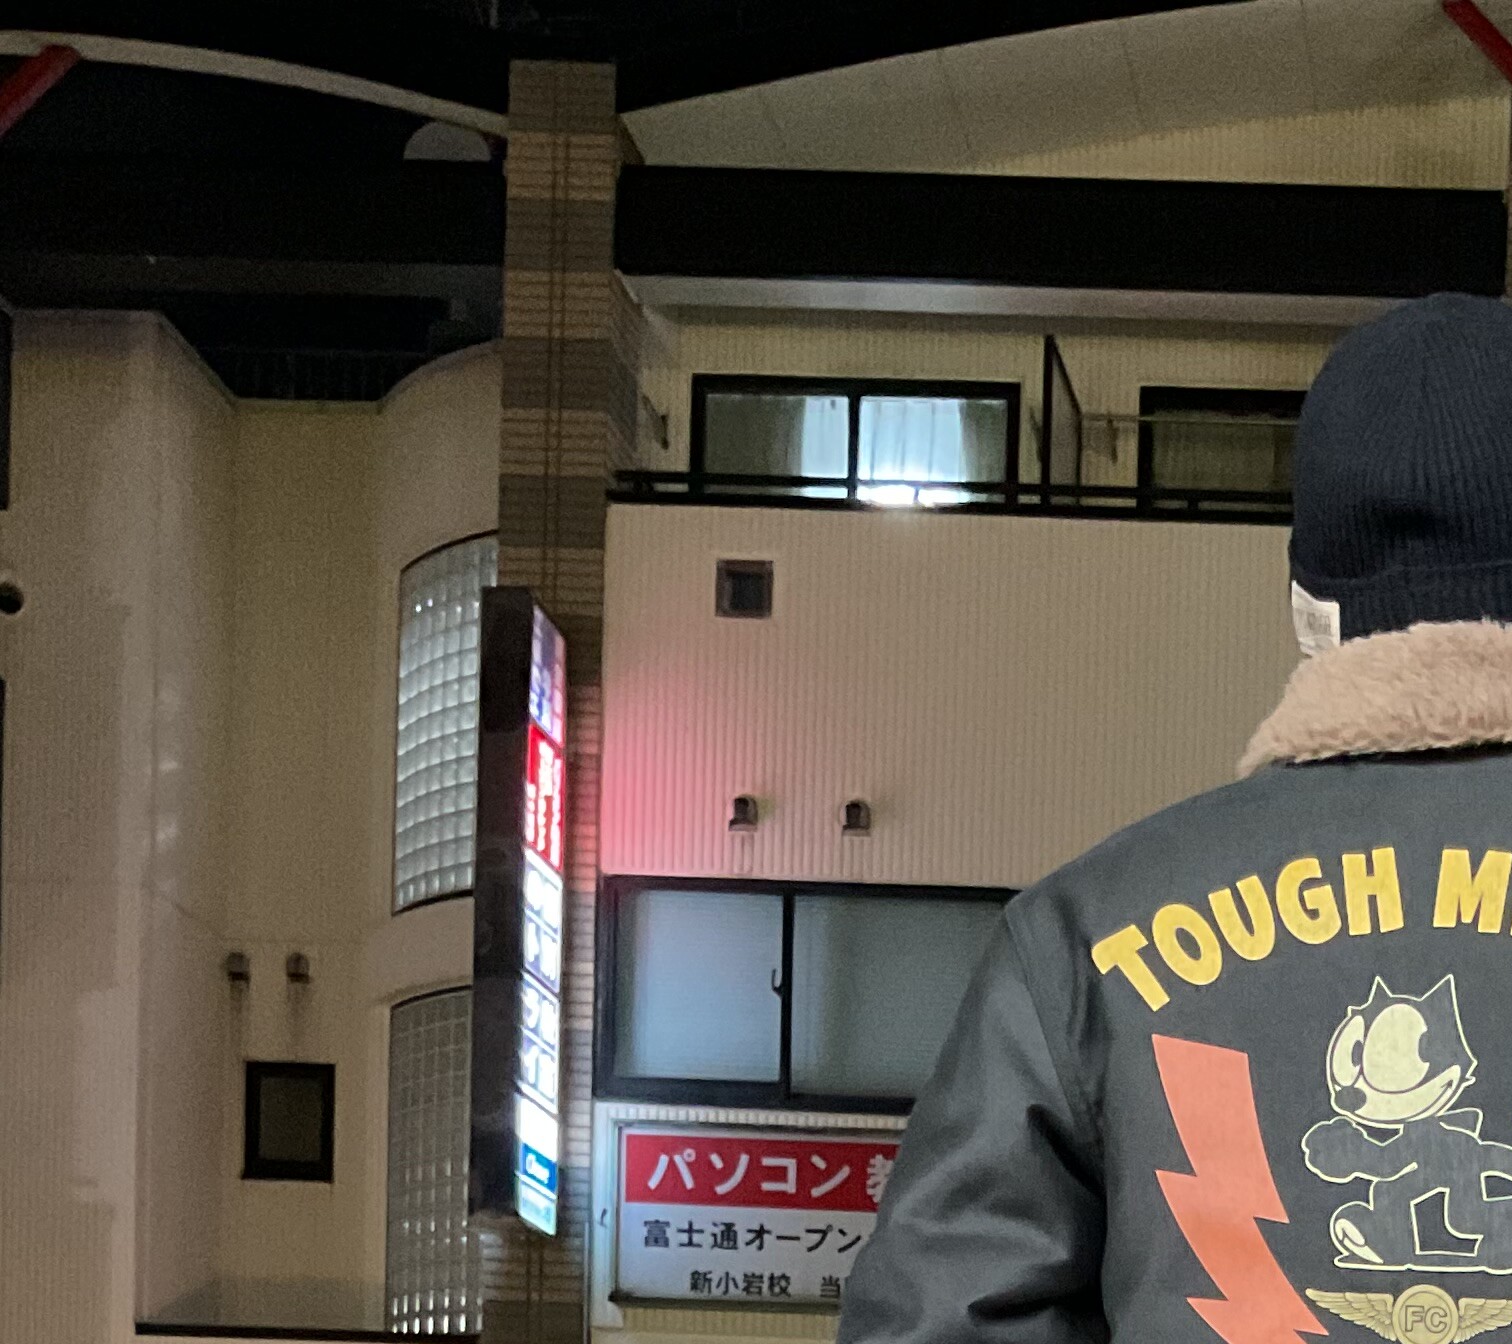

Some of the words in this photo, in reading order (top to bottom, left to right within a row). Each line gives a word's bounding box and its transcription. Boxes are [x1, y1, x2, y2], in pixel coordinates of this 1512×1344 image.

[1091, 846, 1405, 1012] TOUGH
[643, 1219, 862, 1254] 富士通オープン
[689, 1270, 792, 1298] 新小岩校
[1404, 1305, 1448, 1334] FC
